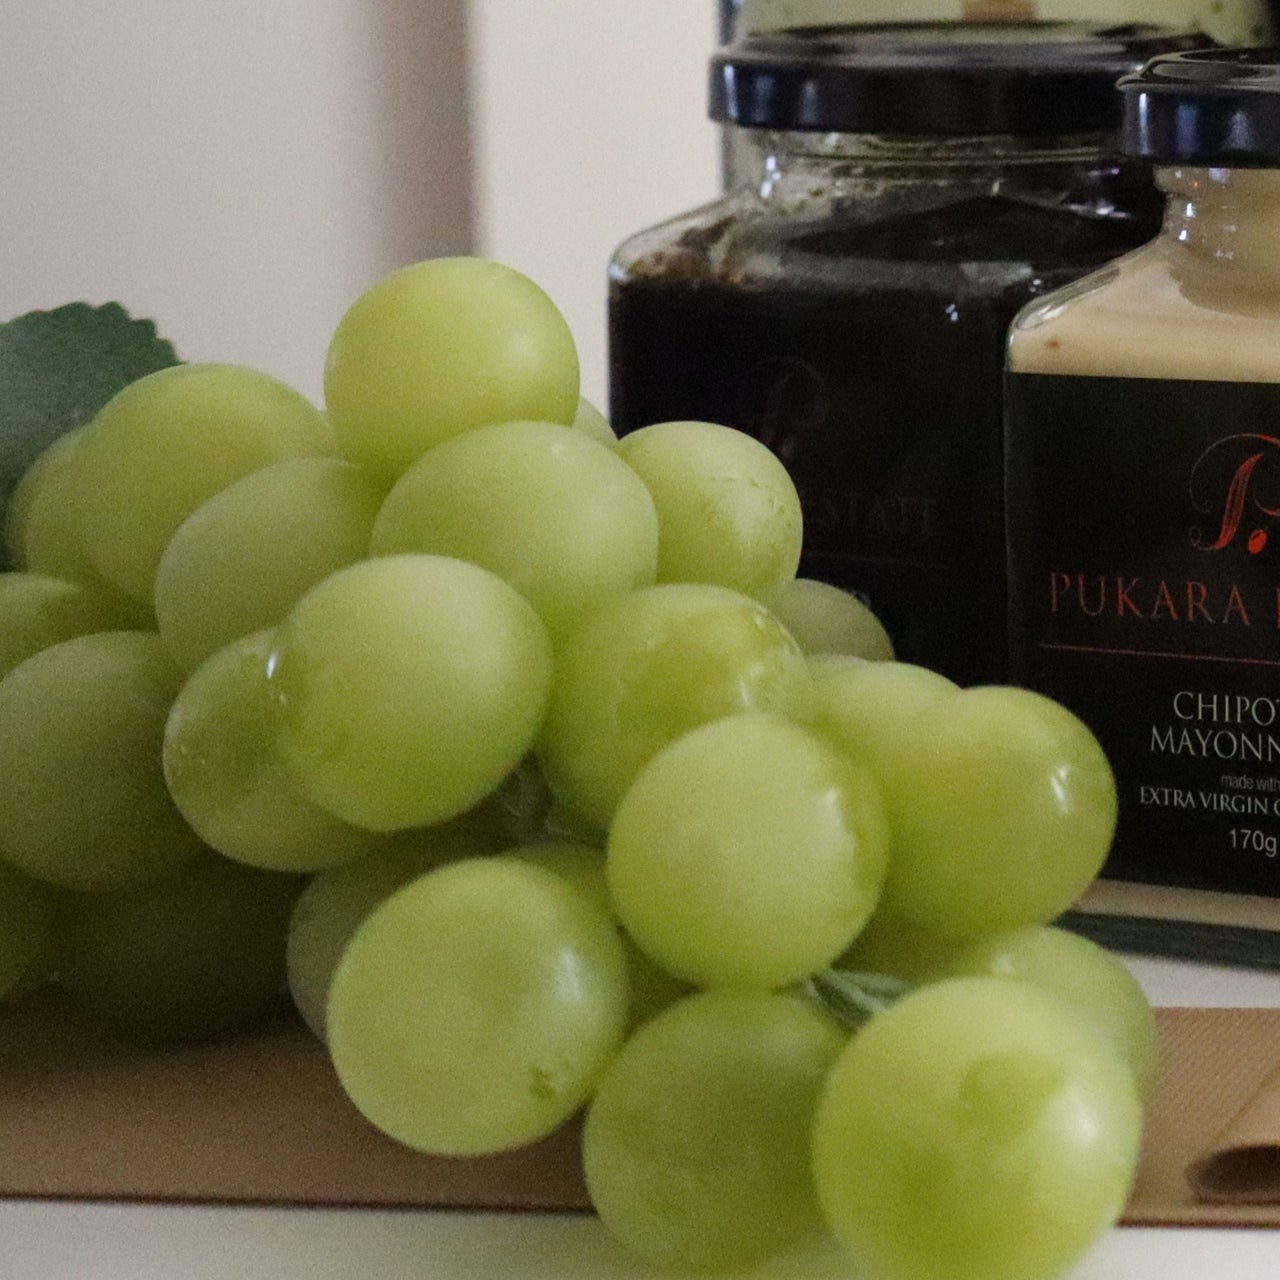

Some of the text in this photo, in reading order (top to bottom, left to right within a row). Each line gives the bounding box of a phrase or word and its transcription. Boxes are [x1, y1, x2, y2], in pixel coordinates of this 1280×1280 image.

[1049, 570, 1252, 628] PUKARA
[1221, 772, 1256, 789] made
[1139, 787, 1198, 809] EXTRA
[1199, 791, 1270, 816] VIRGIN
[1228, 827, 1278, 859] 170g
